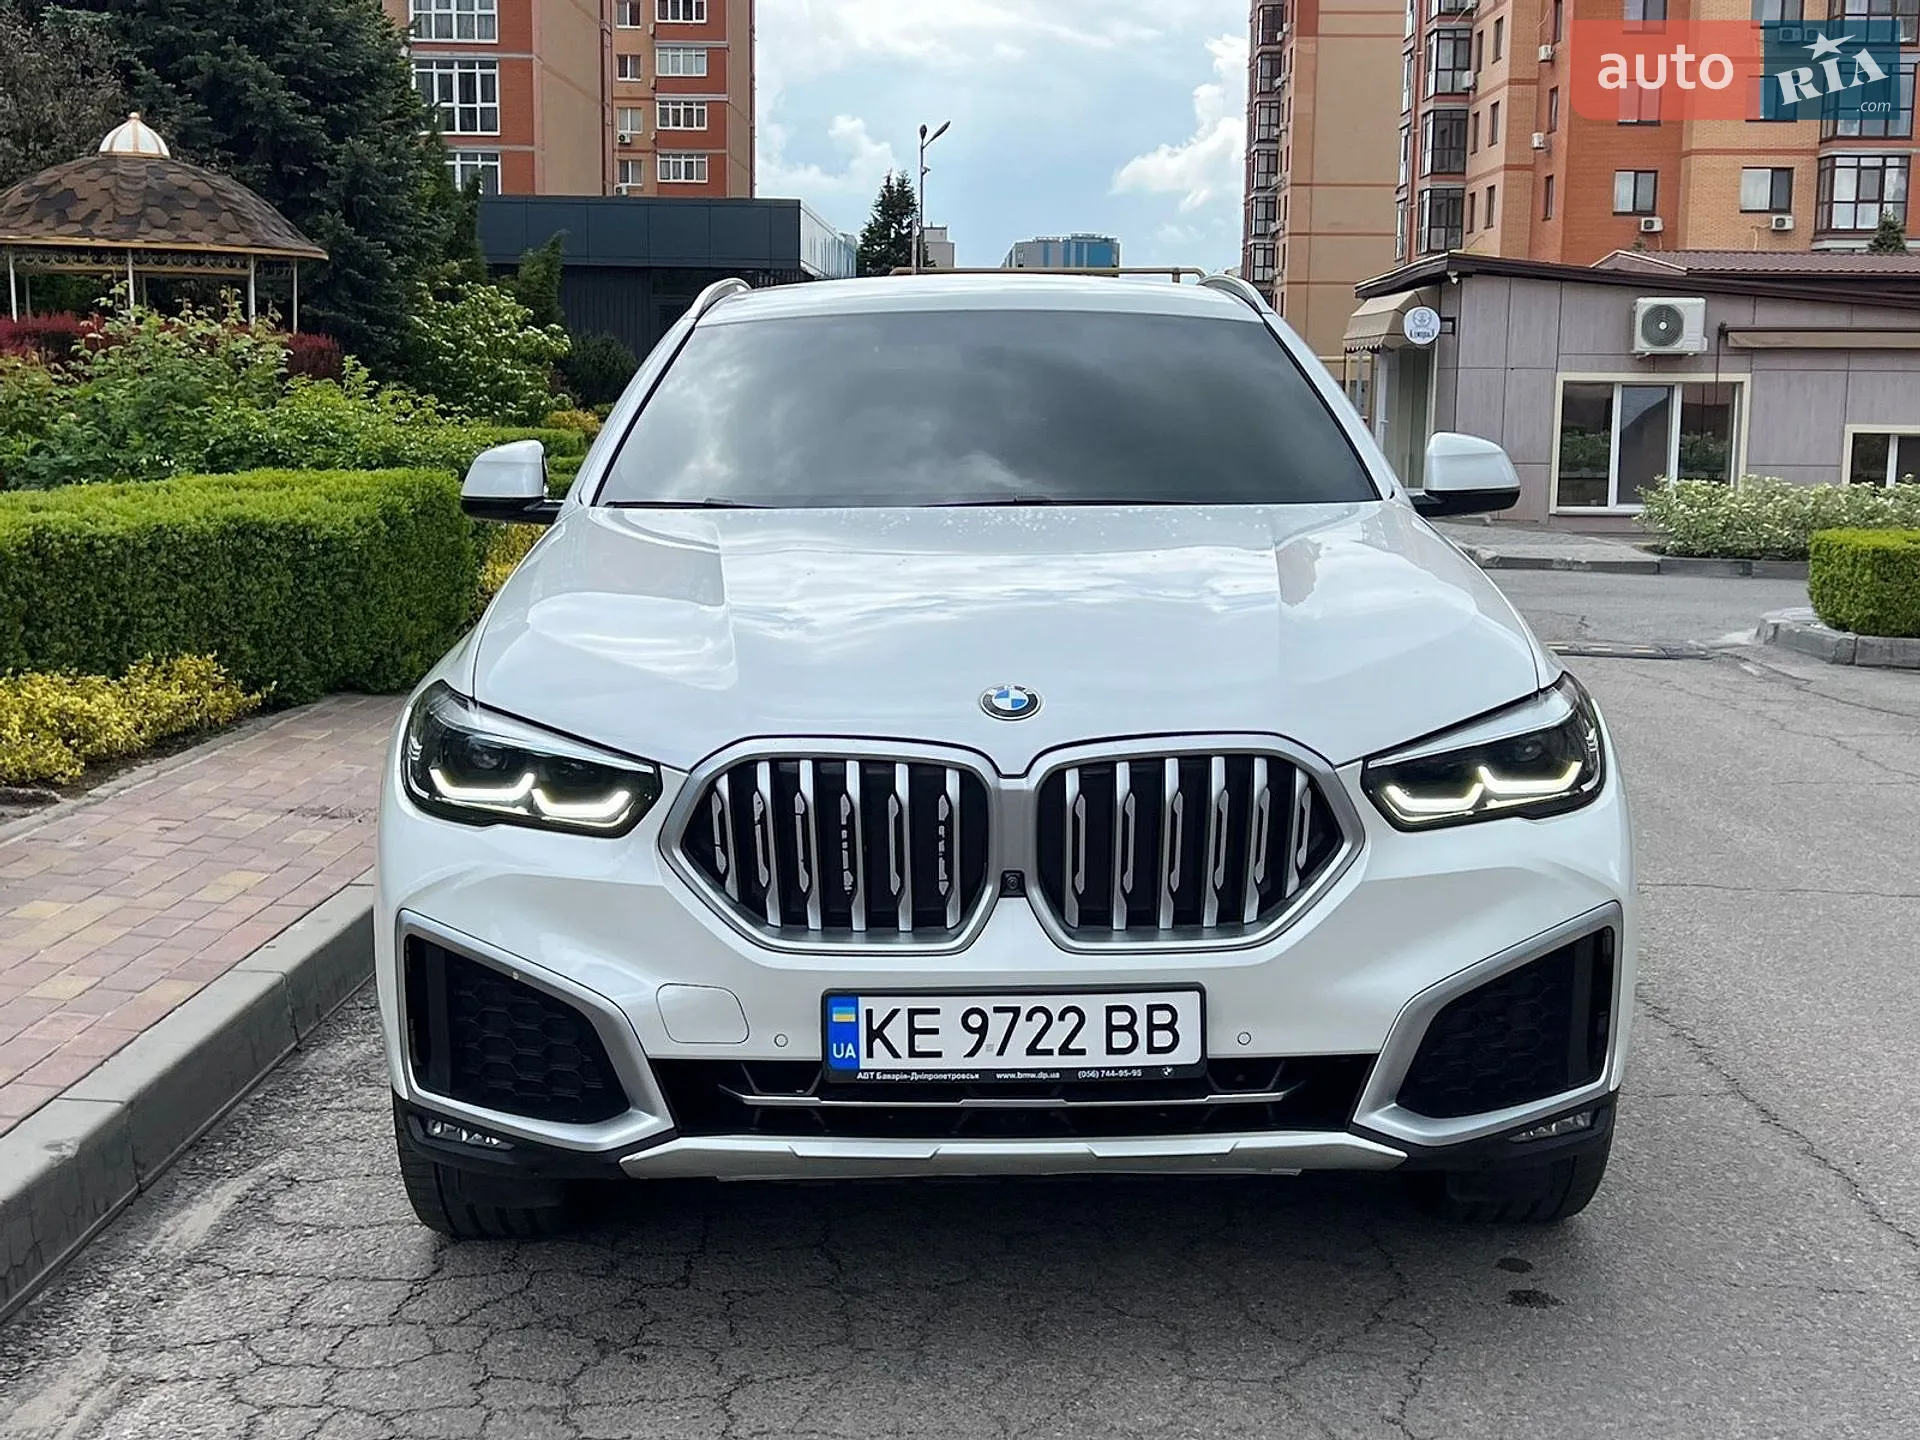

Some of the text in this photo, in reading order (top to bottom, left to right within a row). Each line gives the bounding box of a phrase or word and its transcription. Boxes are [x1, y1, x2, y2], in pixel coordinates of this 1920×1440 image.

[865, 1003, 1180, 1059] KE 9722 BB
[832, 1042, 856, 1060] UA
[996, 1071, 1060, 1080] www.bmw.dp.ua
